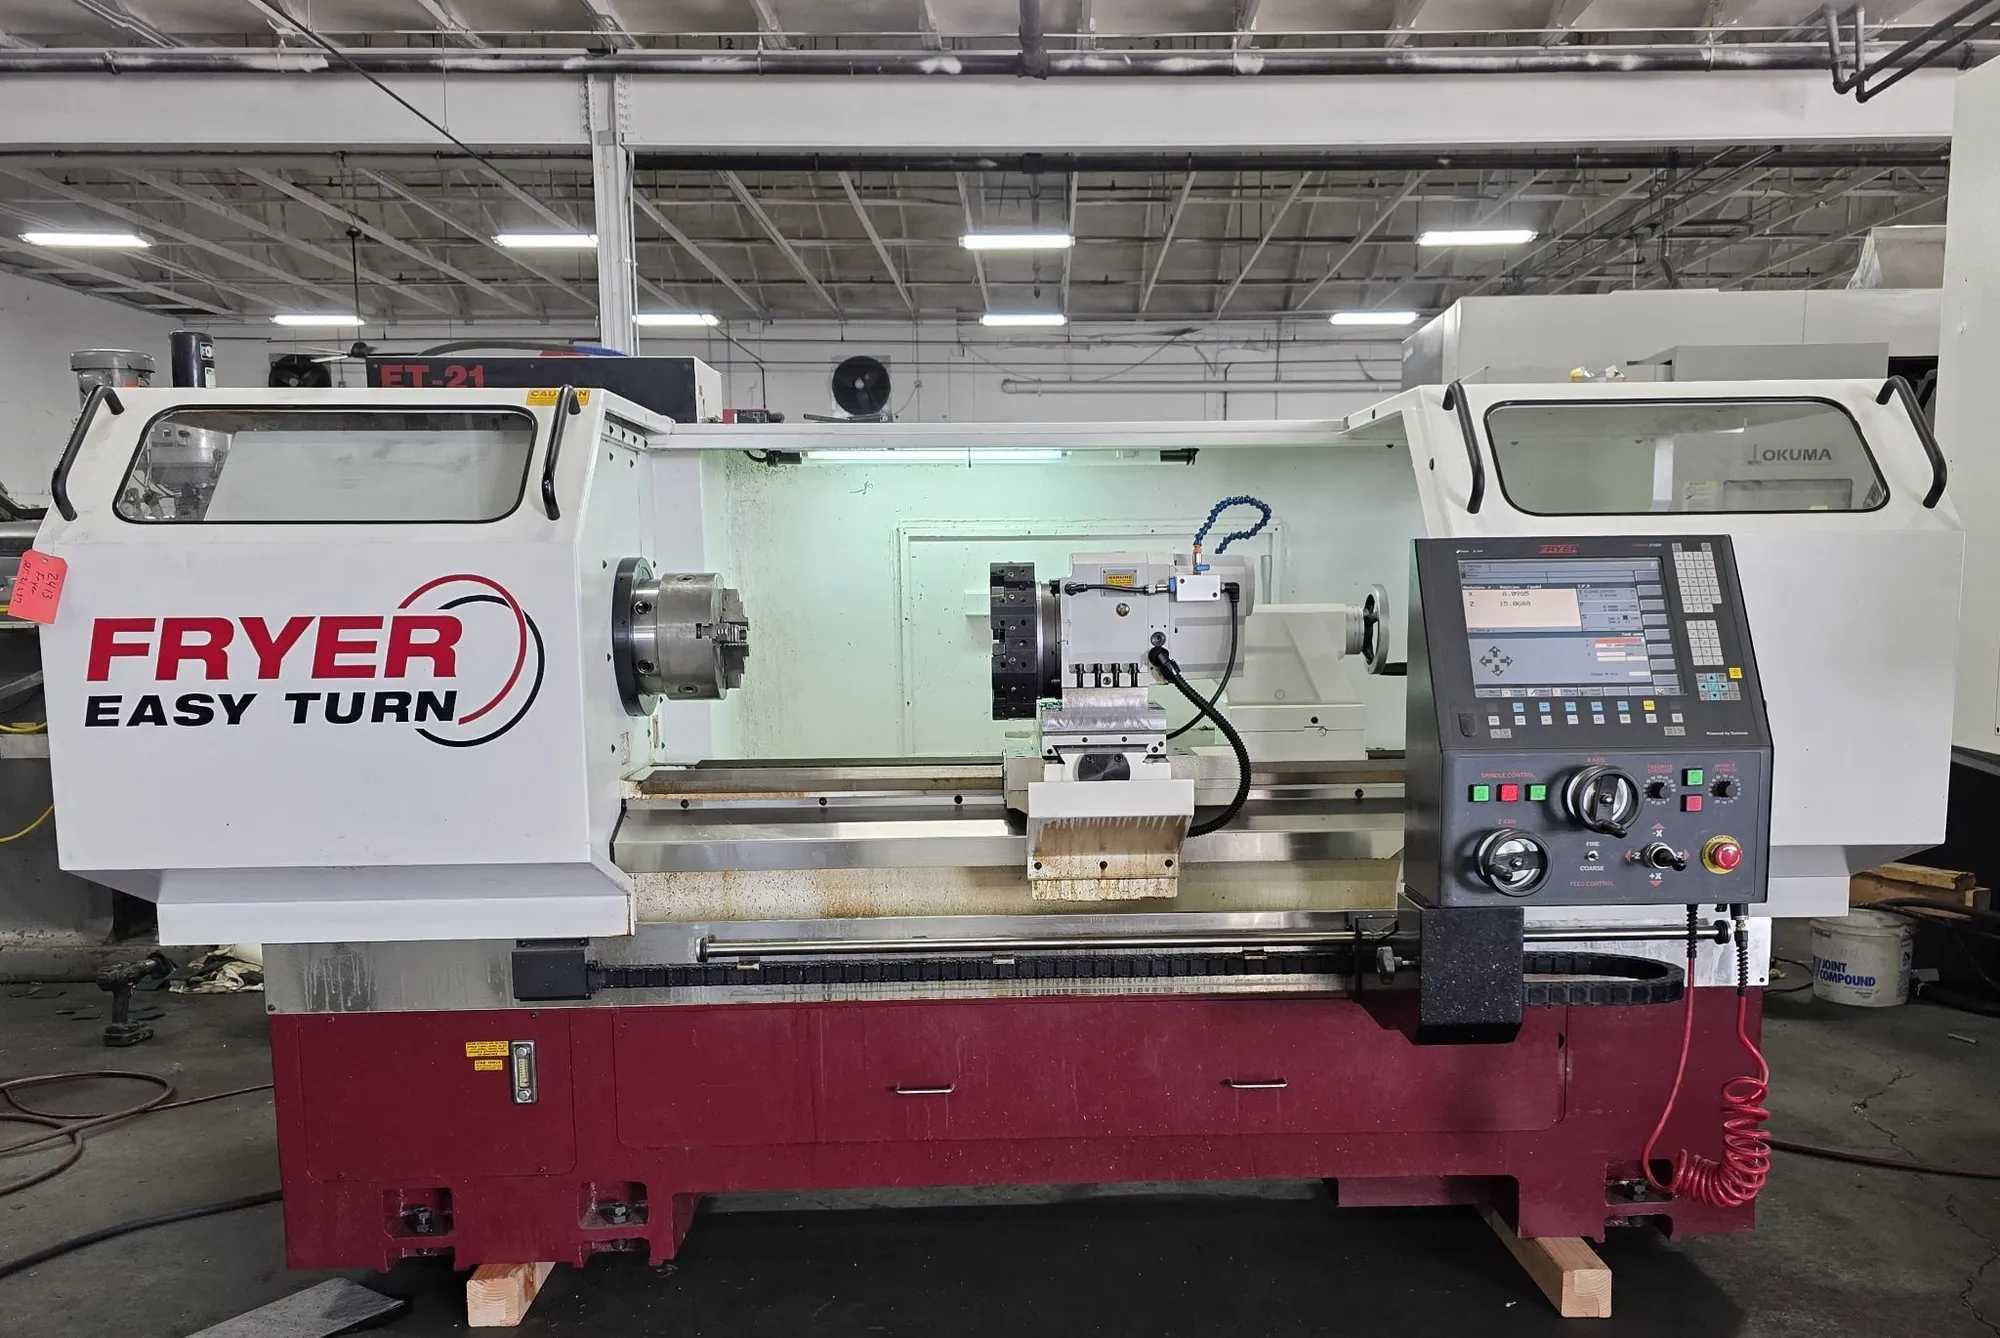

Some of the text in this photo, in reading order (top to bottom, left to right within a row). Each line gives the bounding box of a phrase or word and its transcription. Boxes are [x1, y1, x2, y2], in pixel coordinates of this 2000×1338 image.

[379, 364, 486, 388] ET-21
[1762, 448, 1833, 462] OKUMA
[86, 615, 463, 682] FRYER
[85, 690, 458, 728] EASY TURN
[1822, 959, 1847, 973] JOINT
[1820, 970, 1876, 987] COMPOUND
